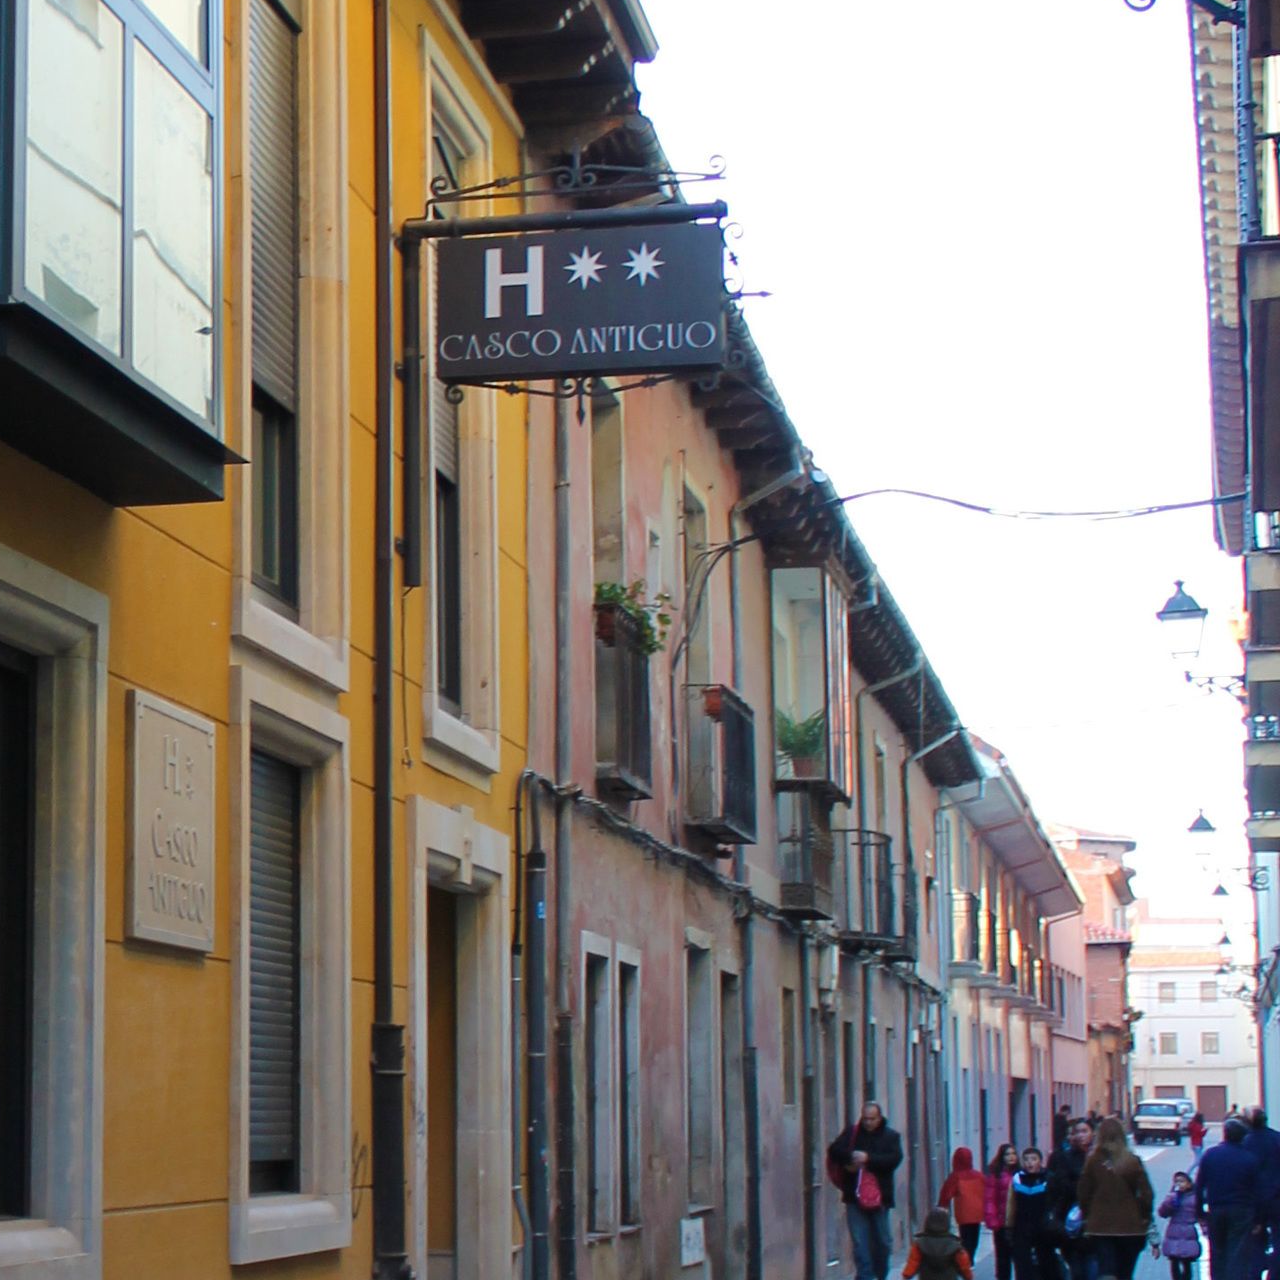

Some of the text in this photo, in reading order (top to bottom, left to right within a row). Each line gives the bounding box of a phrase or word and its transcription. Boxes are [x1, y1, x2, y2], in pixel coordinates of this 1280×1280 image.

[484, 245, 545, 319] H
[439, 321, 717, 362] CASCO ANTIGUO
[163, 735, 182, 796] H
